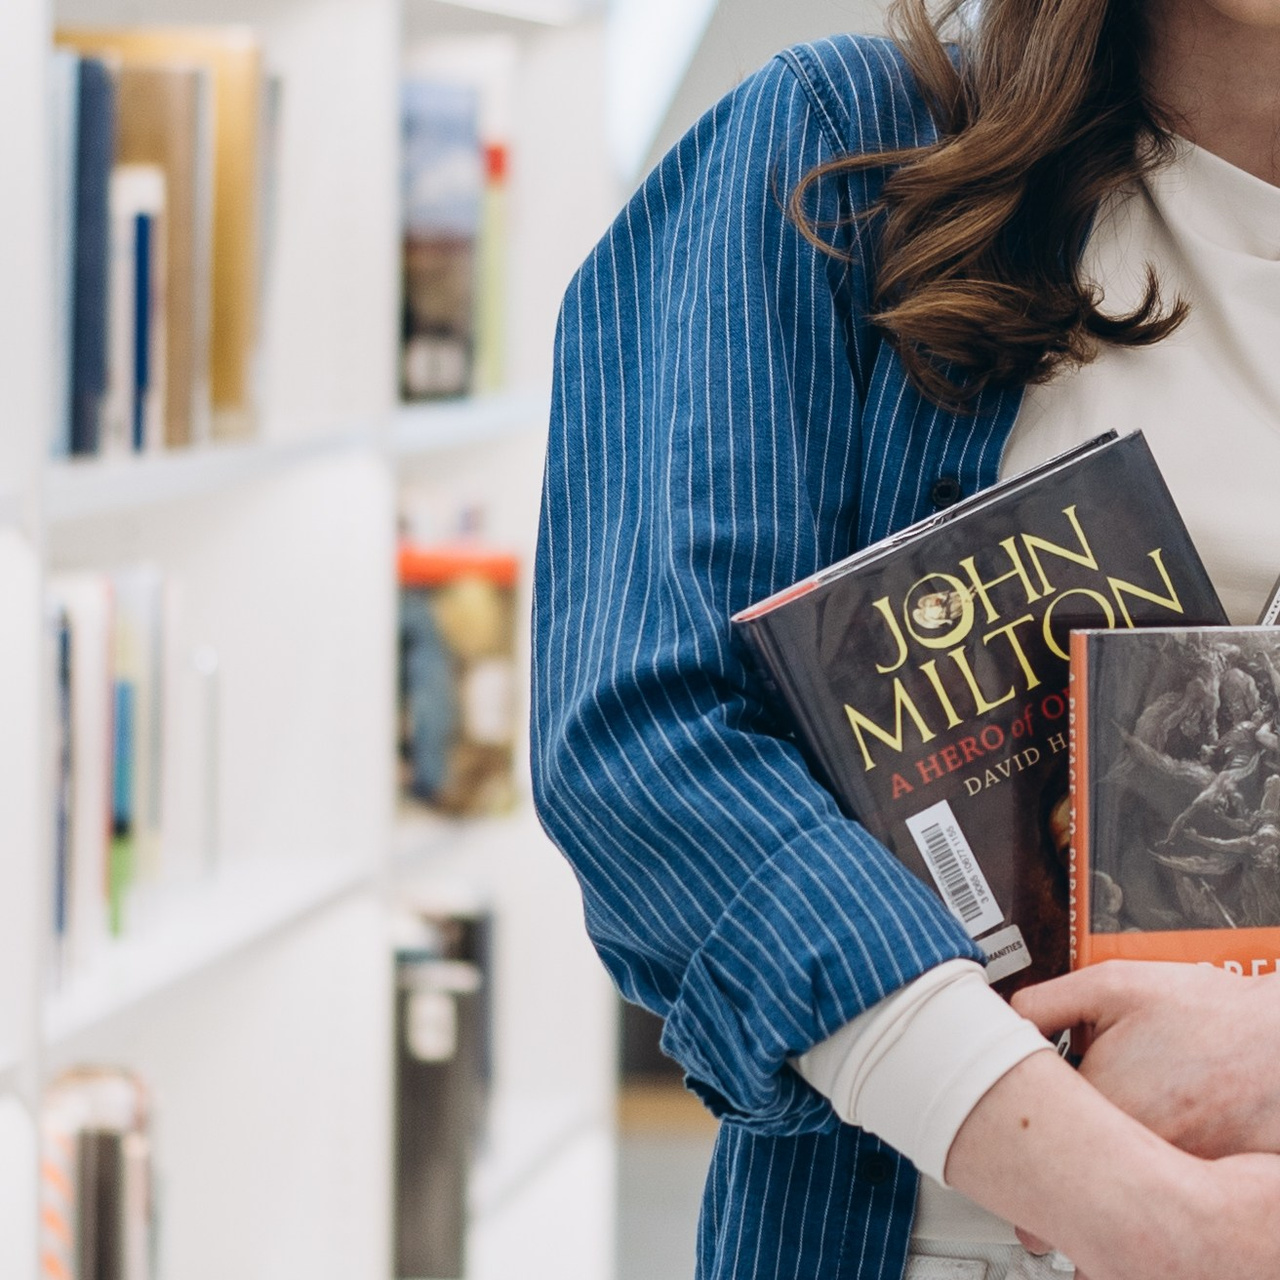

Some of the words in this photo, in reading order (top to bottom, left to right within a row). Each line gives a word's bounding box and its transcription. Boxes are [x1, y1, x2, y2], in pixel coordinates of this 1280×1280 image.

[873, 505, 1100, 673] JOHN
[844, 548, 1184, 771] MILTON
[890, 772, 914, 800] A
[915, 723, 1004, 784] HERO
[1011, 702, 1033, 738] of
[963, 746, 1040, 797] DAVID
